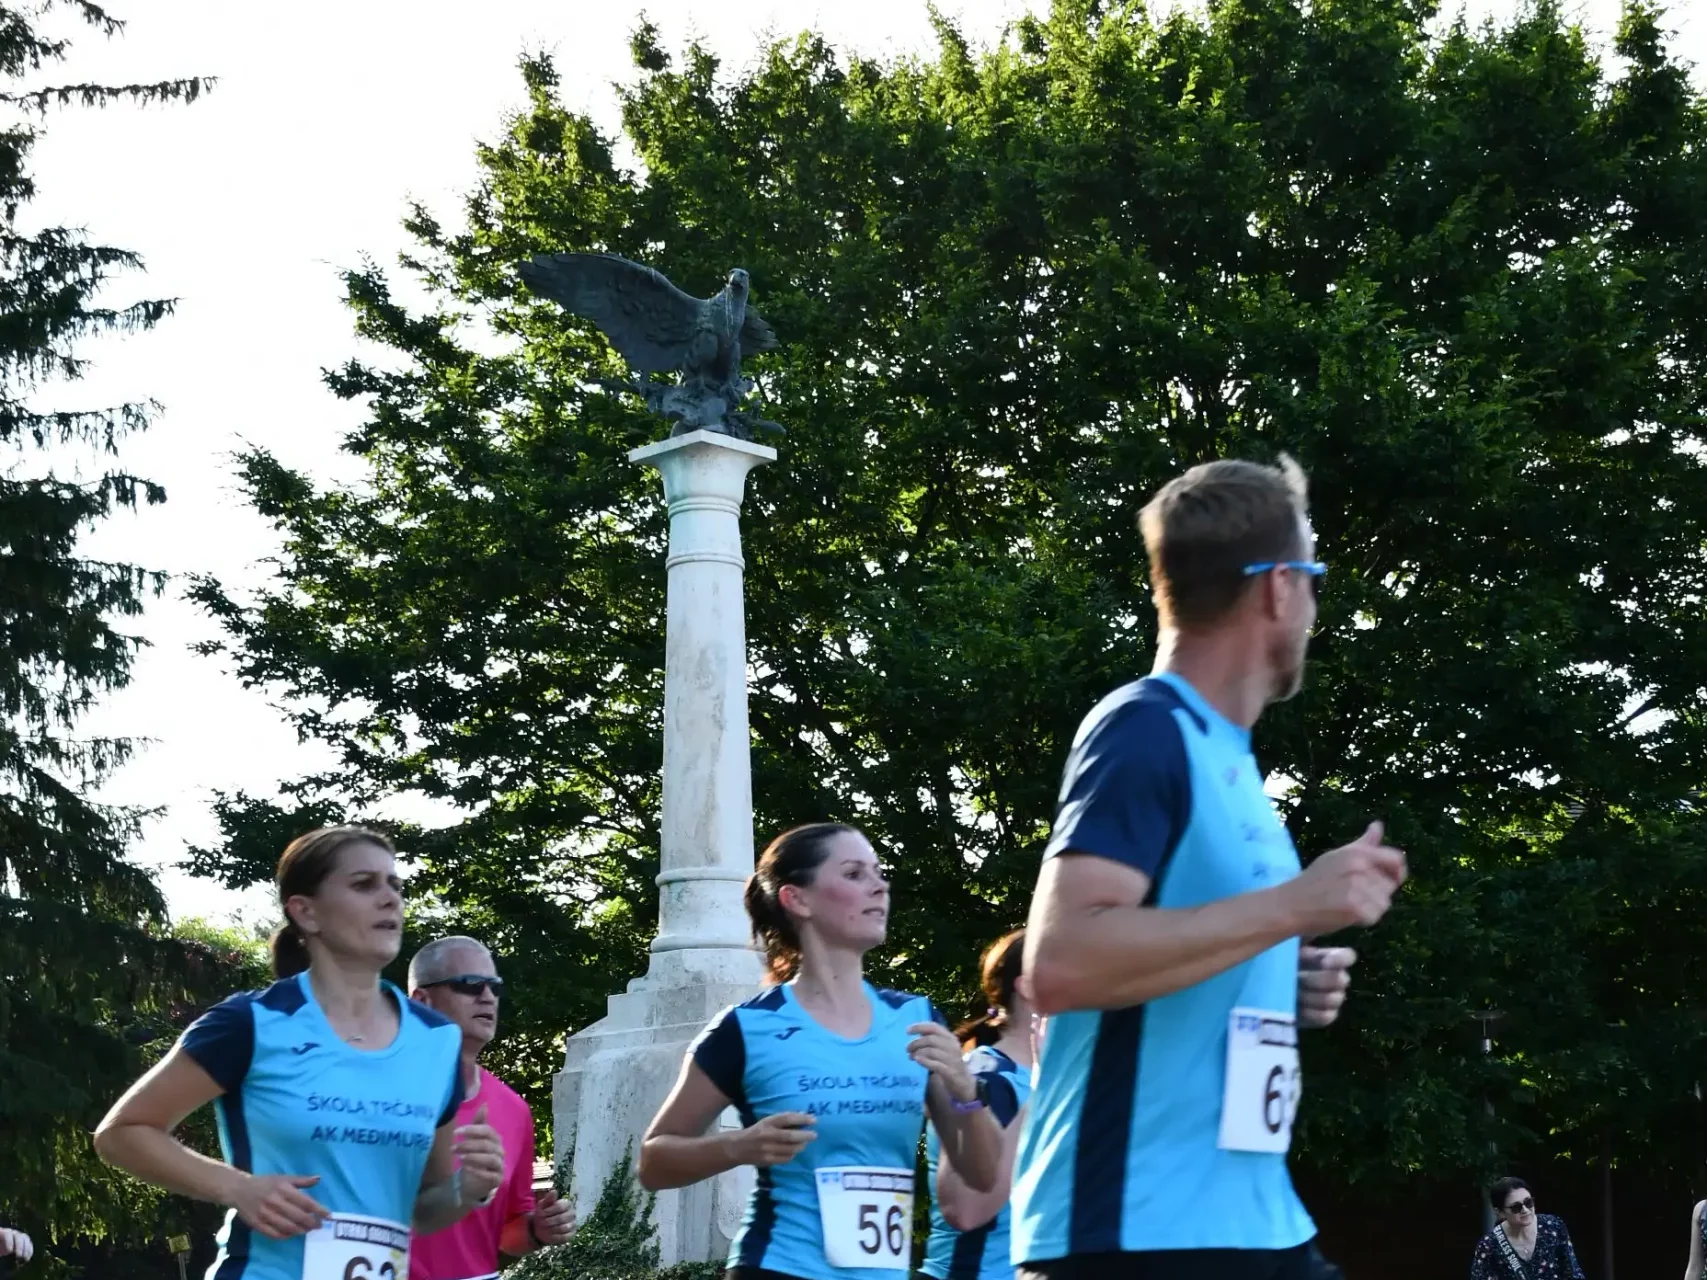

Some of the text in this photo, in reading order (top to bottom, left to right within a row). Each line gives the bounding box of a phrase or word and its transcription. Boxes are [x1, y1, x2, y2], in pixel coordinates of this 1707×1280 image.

[806, 1102, 832, 1116] AK
[310, 1125, 338, 1142] AK
[858, 1204, 904, 1256] 56
[1507, 1253, 1522, 1272] SOUL
